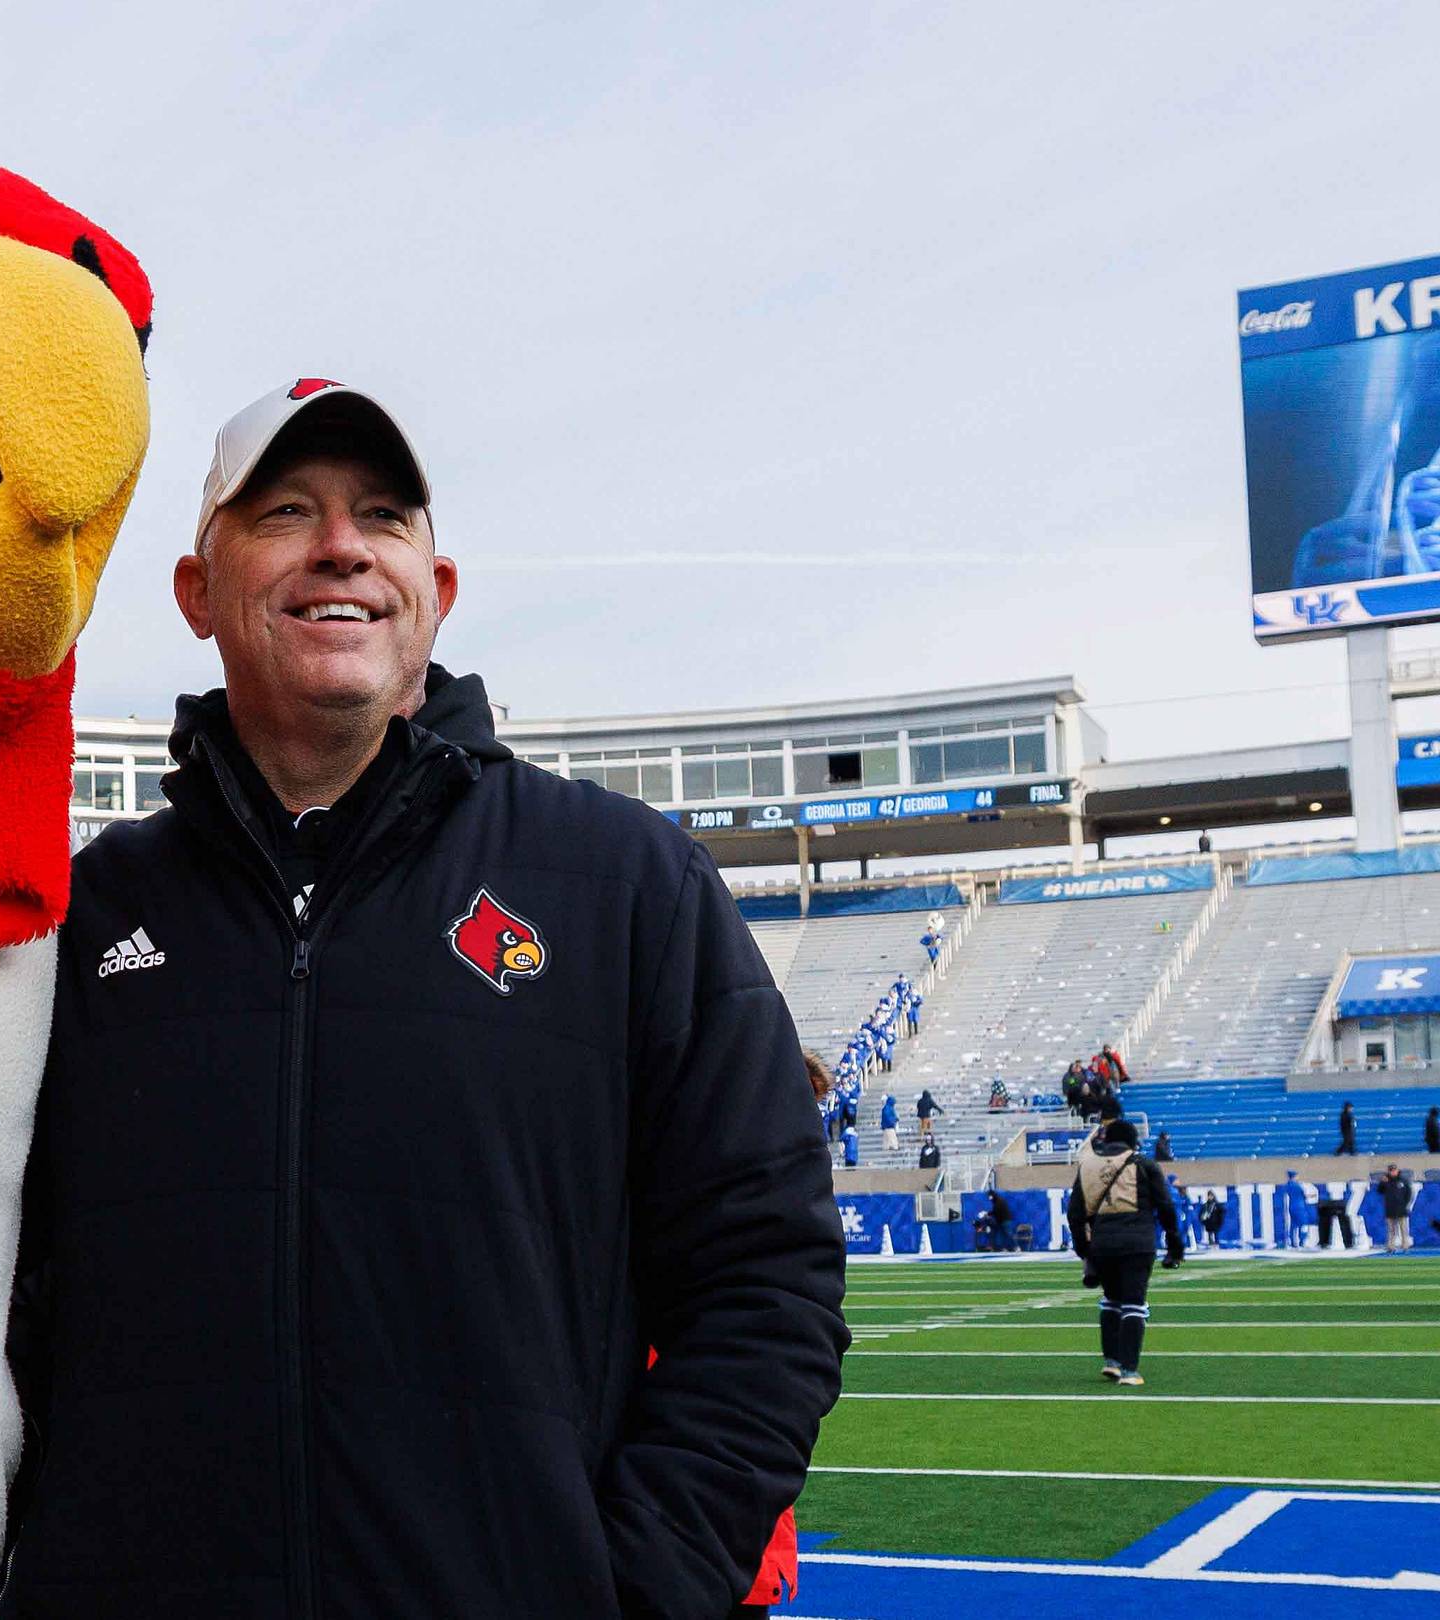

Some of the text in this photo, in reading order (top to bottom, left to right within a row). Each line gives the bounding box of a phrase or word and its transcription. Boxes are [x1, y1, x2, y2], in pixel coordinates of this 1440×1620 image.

[805, 803, 845, 820] GEORGIA
[846, 801, 870, 817] TECH
[903, 795, 948, 813] GEORGIA
[976, 790, 992, 807] 44
[1030, 784, 1063, 802] FINAL
[691, 812, 715, 828] 7:00
[716, 810, 733, 827] PM
[98, 951, 166, 978] adidas
[1376, 967, 1428, 990] K
